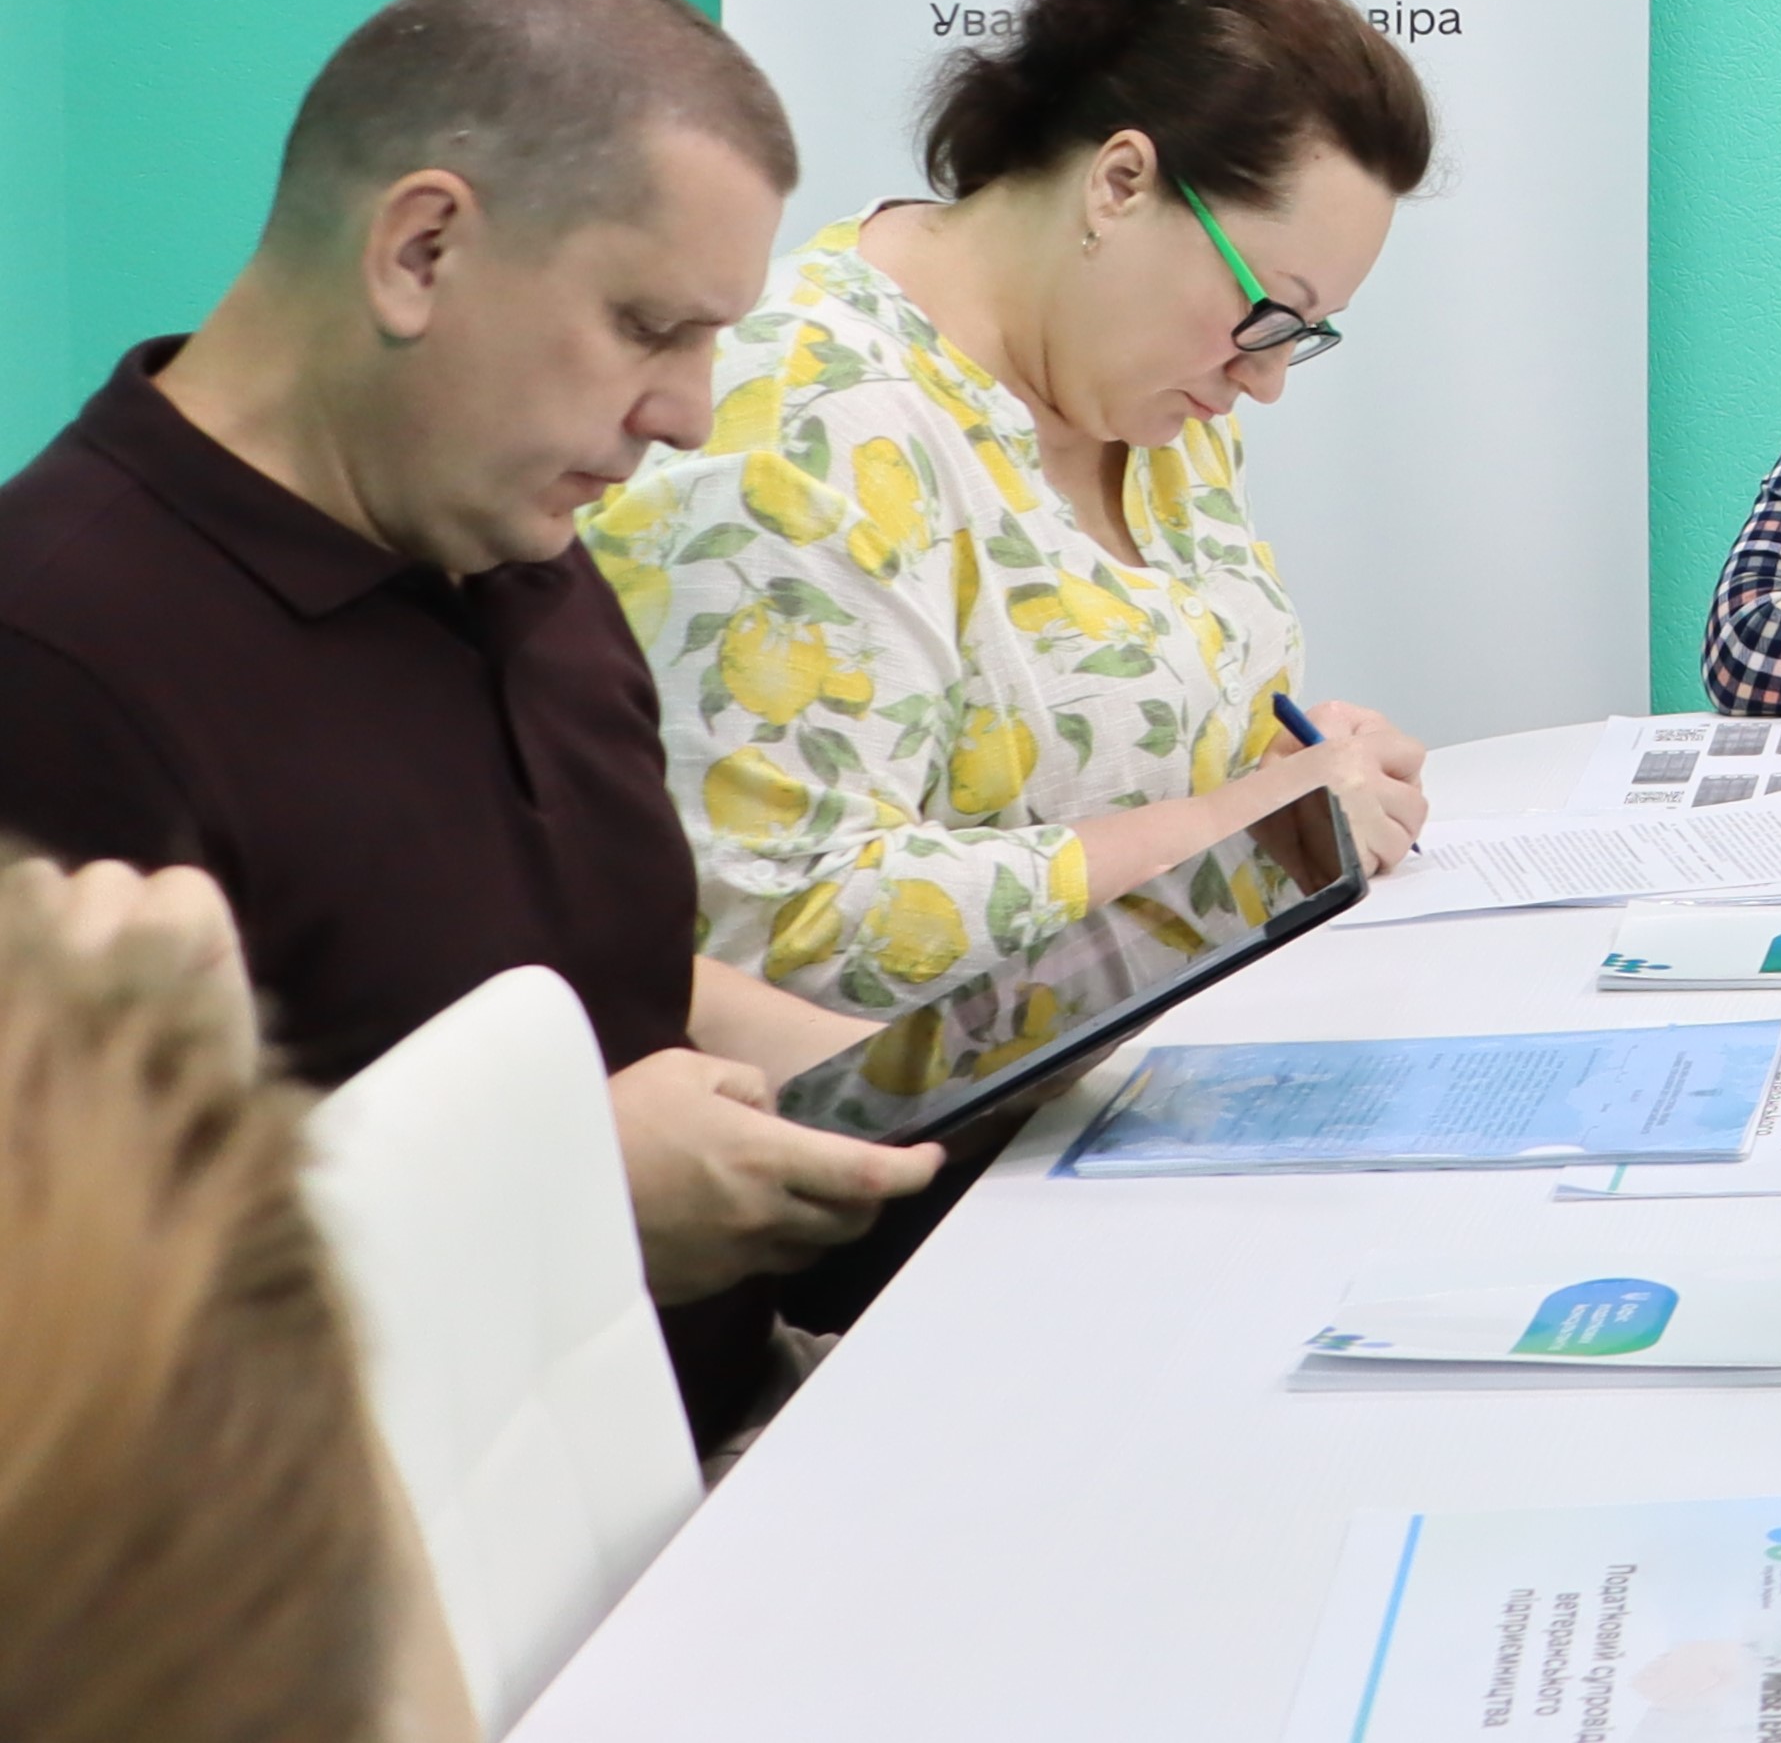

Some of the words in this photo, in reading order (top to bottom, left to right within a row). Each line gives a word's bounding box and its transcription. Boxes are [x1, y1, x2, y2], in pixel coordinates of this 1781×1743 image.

[1481, 1587, 1543, 1729] підприємництва
[1534, 1591, 1582, 1717] ветеранського
[1591, 1563, 1638, 1661] Податковий
